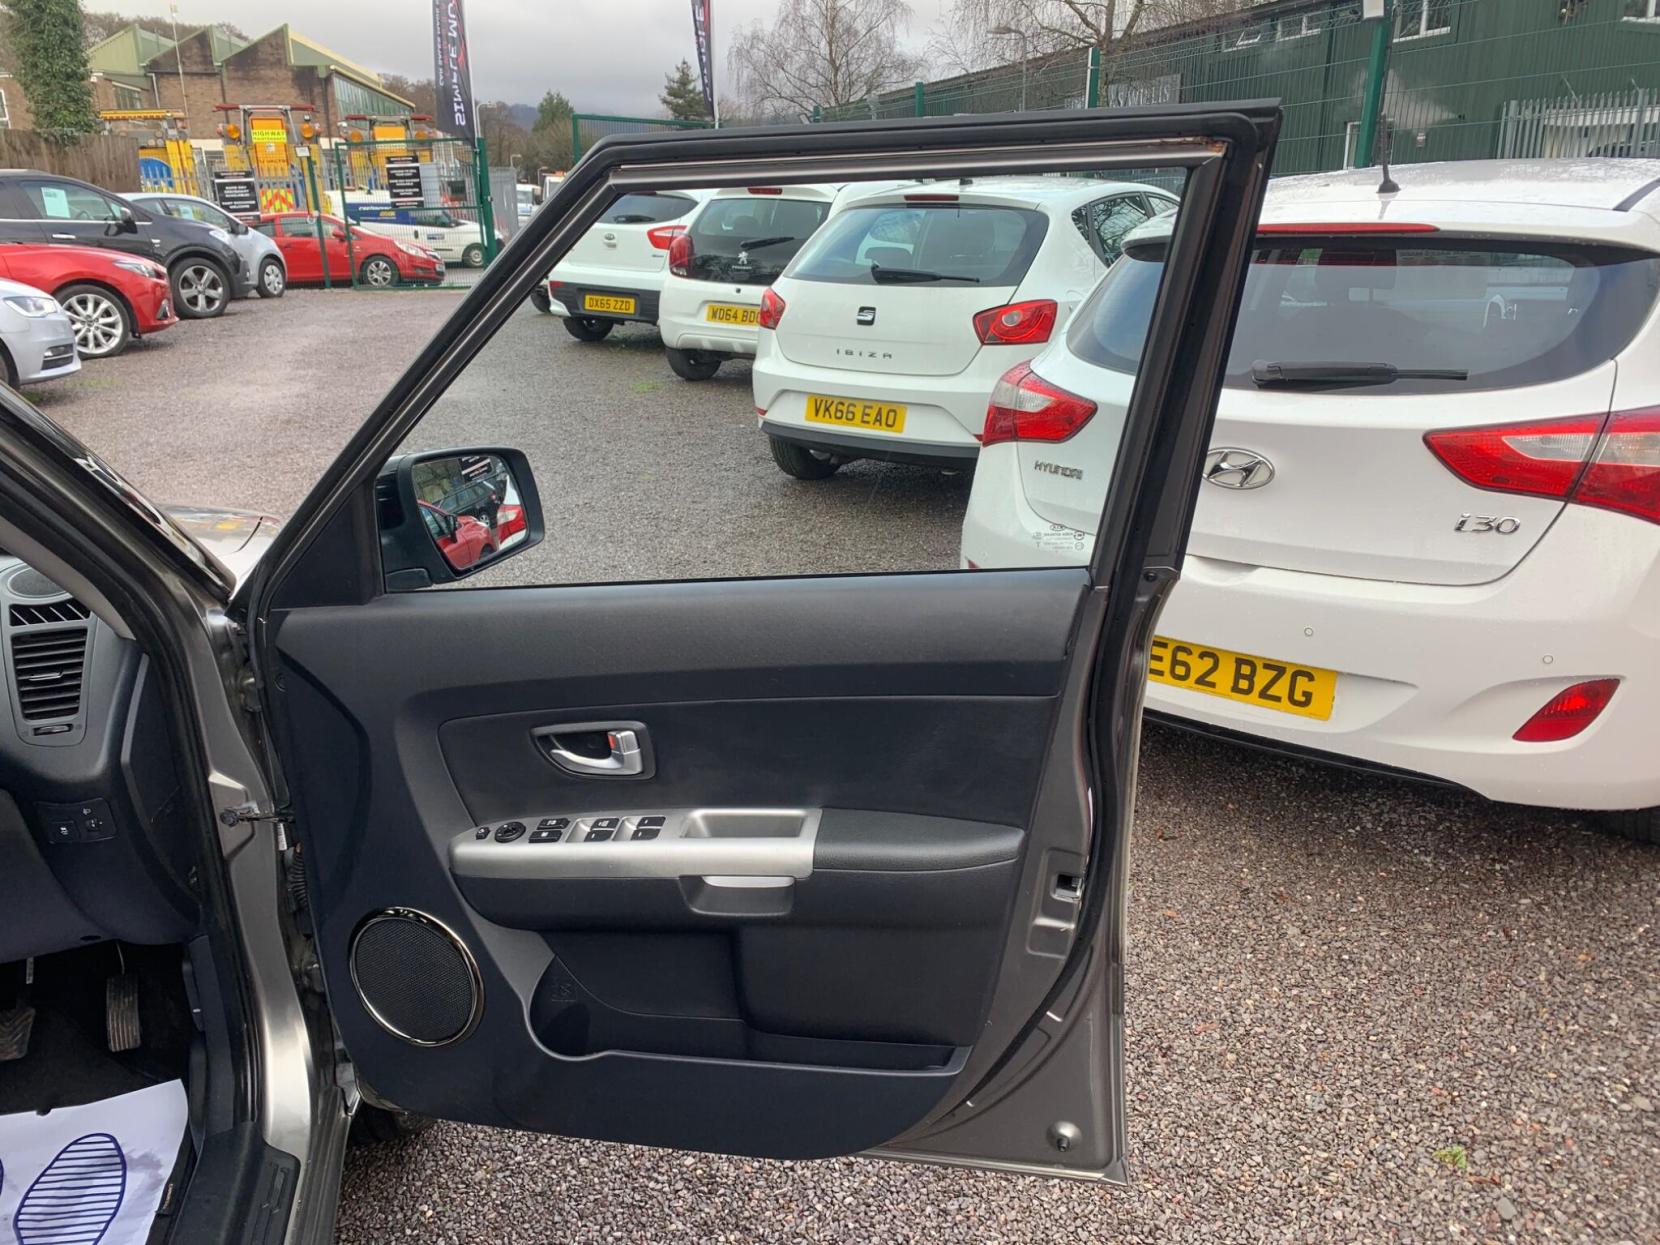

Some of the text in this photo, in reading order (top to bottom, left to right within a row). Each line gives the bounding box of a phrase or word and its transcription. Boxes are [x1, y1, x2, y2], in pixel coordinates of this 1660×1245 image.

[588, 297, 611, 310] DX65
[836, 348, 892, 359] IBIZA
[814, 398, 856, 422] VK66
[1034, 460, 1083, 480] HYUNDAI
[1454, 513, 1521, 534] i30
[1230, 656, 1315, 708] BZG
